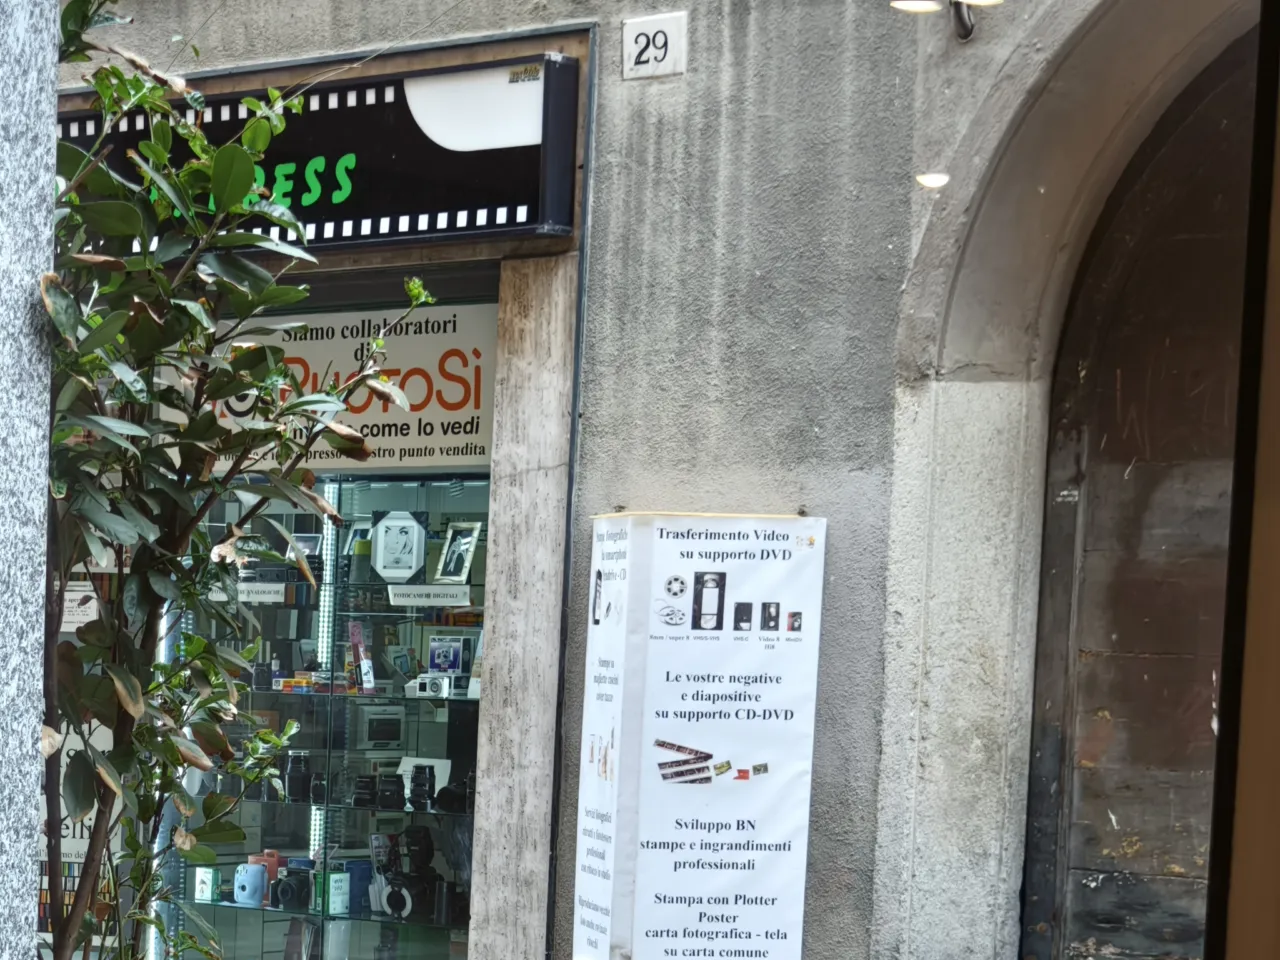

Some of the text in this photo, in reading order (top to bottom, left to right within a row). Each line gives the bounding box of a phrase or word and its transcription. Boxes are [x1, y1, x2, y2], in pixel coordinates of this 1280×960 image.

[634, 30, 668, 66] 29
[341, 314, 457, 339] collaboratori
[360, 422, 410, 437] come
[417, 417, 434, 436] lo
[440, 416, 480, 436] vedi
[399, 445, 435, 461] punto
[439, 442, 486, 456] vendita
[657, 528, 789, 541] Trasferimento Video
[680, 550, 792, 562] su supporto DVD
[666, 671, 782, 685] Le vostre negative
[681, 690, 761, 704] e diapositive
[655, 709, 794, 722] su supporto CD-DVD
[675, 819, 756, 833] Sviluppo BN
[640, 839, 791, 853] stampe e ingrandimenti
[674, 859, 755, 872] professionali
[654, 893, 777, 907] Stampa con Plotter
[699, 912, 738, 923] Poster
[645, 929, 678, 938] carta
[683, 927, 752, 941] fotografica
[765, 928, 788, 940] tela
[664, 948, 769, 958] su carta comune
